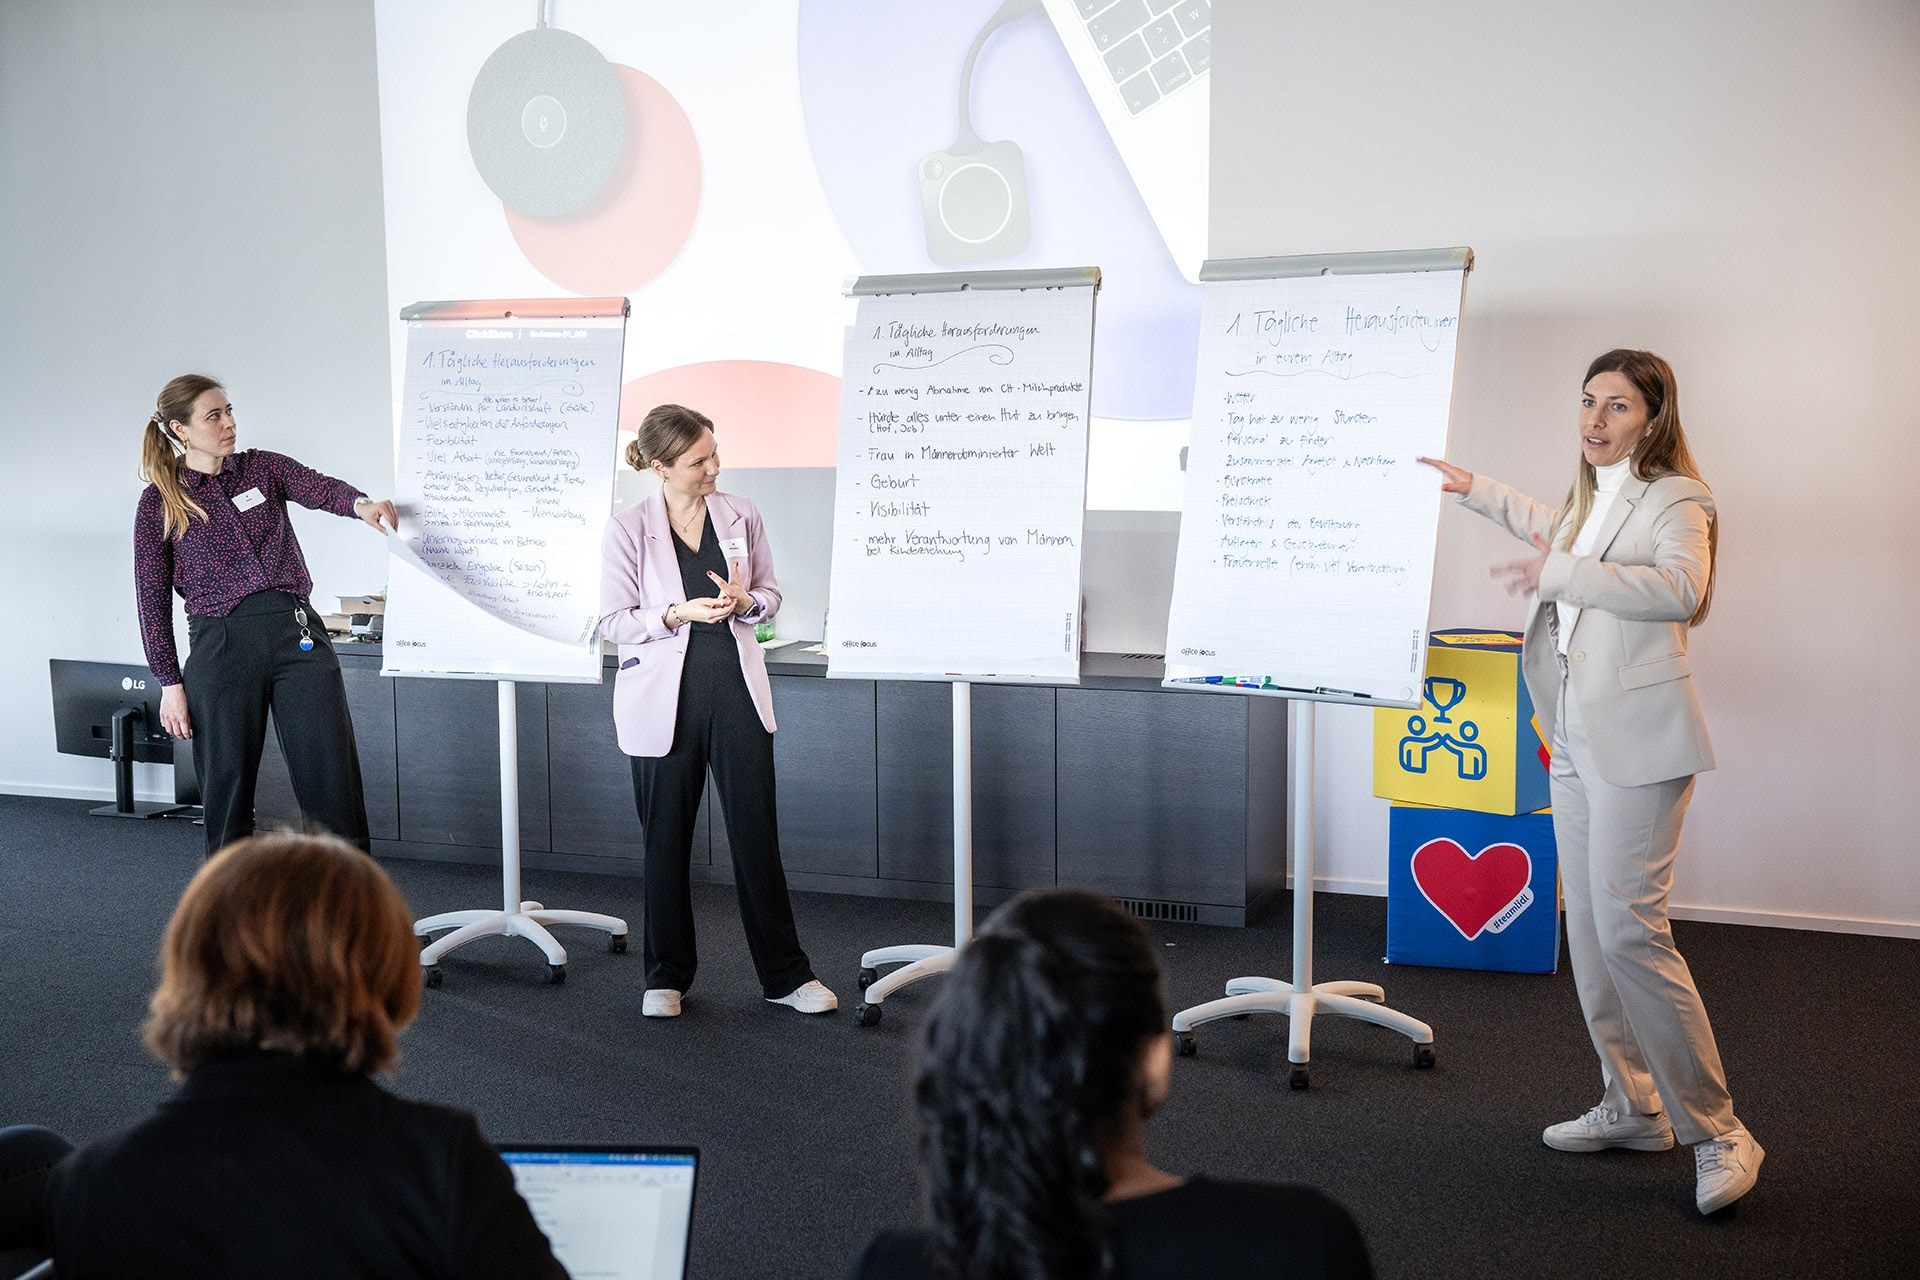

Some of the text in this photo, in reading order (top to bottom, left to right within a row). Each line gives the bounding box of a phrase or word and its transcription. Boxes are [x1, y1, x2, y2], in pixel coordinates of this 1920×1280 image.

[872, 320, 1040, 347] 1. Tägliche Herausforderungen
[438, 349, 487, 374] Tägliche
[491, 352, 596, 373] Herausforderungen
[889, 346, 933, 362] im Alltag
[894, 386, 919, 401] wenig
[926, 384, 971, 395] Abnahme
[978, 386, 993, 394] von
[868, 410, 900, 424] Hürde
[906, 410, 930, 423] alles
[935, 411, 962, 423] unter
[965, 412, 996, 422] einen
[1000, 407, 1021, 422] Hut
[1028, 411, 1042, 421] zu
[868, 447, 895, 461] Frau
[904, 450, 915, 459] in
[1029, 441, 1056, 457] Welt
[870, 473, 921, 490] Geburt
[870, 500, 932, 517] Visibilität
[865, 544, 881, 557] bei
[868, 532, 896, 545] mehr
[905, 529, 991, 556] Verantwortung
[998, 536, 1019, 546] von
[133, 680, 146, 690] LG
[1493, 893, 1530, 930] #teamlidl
